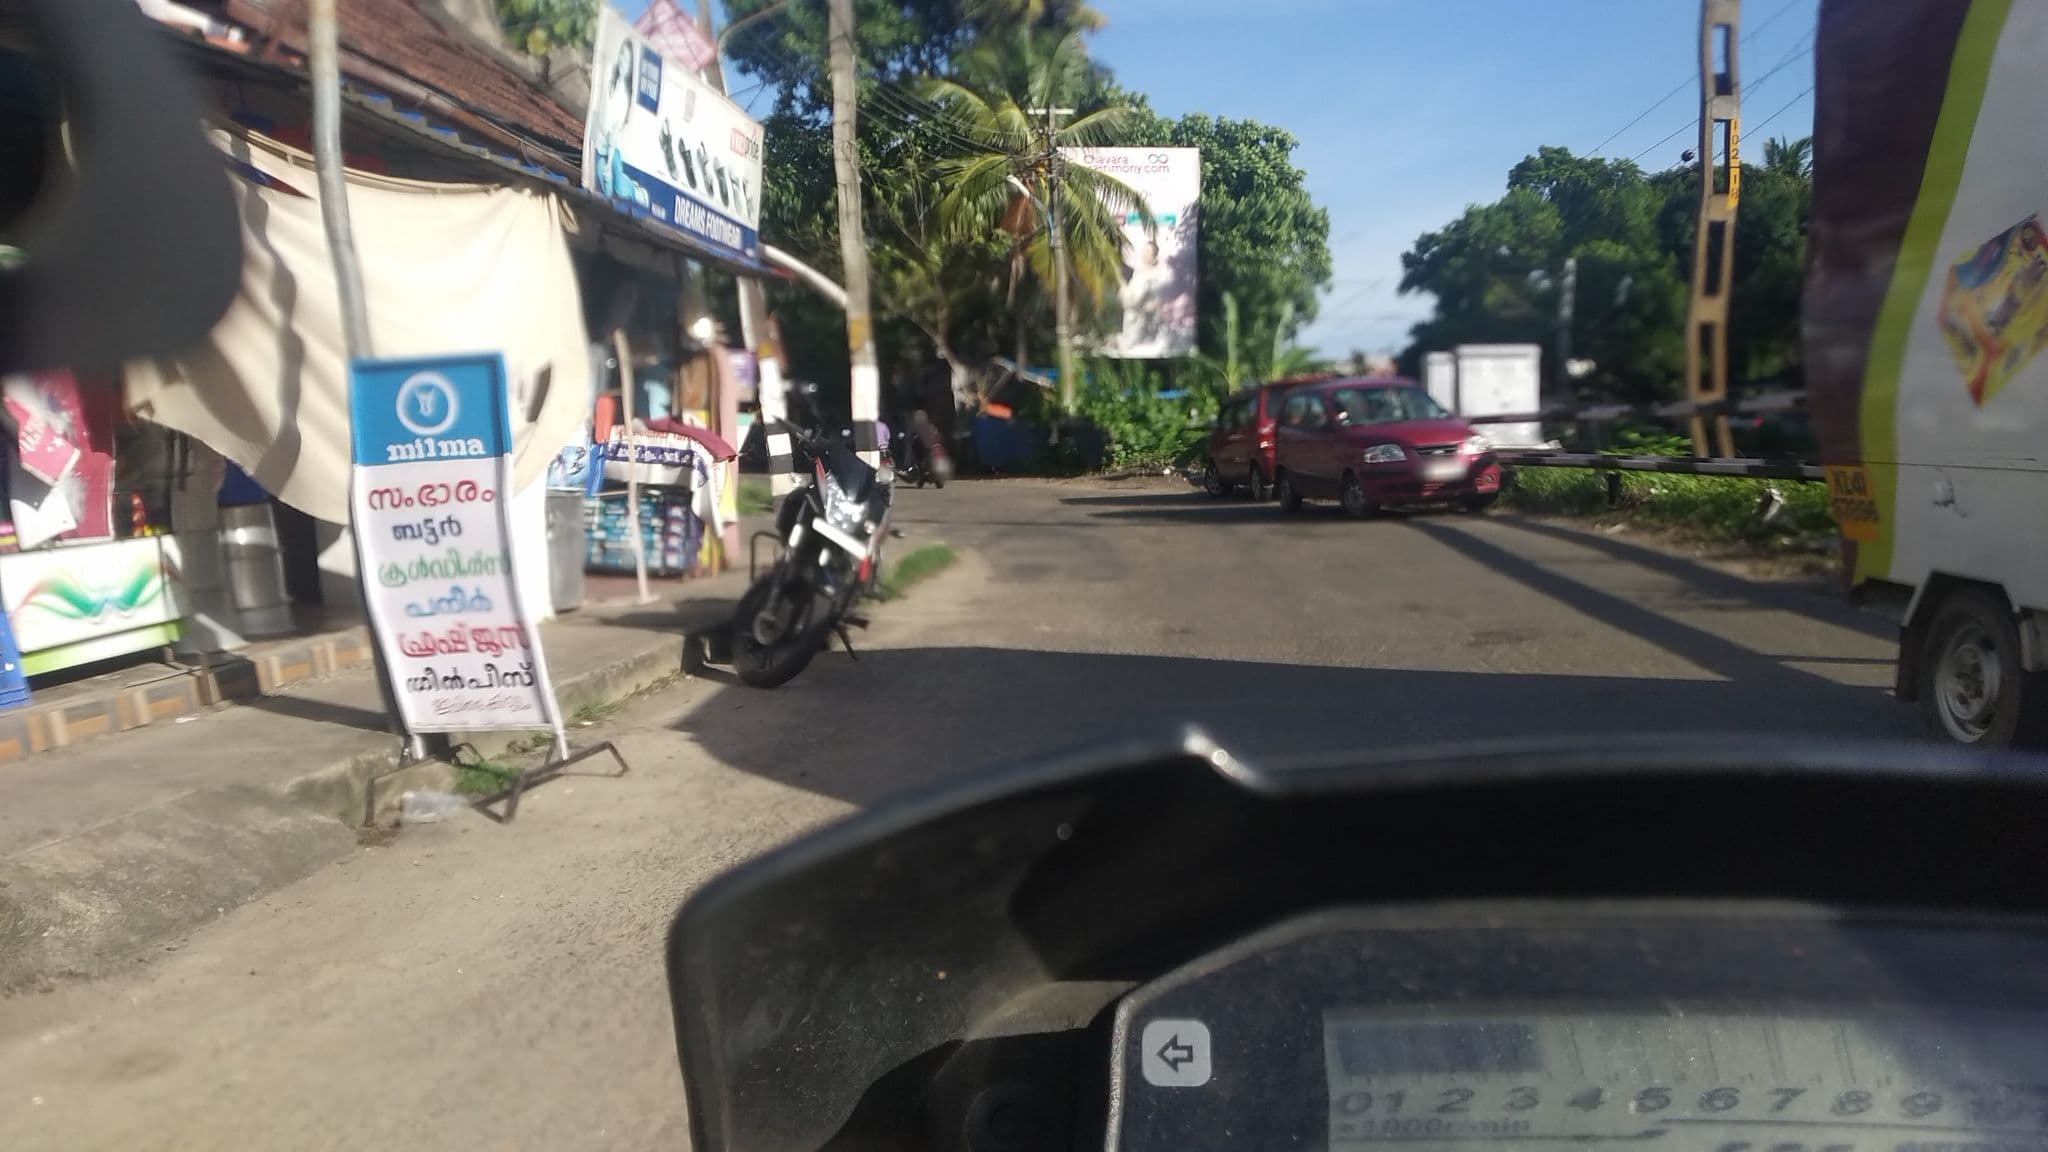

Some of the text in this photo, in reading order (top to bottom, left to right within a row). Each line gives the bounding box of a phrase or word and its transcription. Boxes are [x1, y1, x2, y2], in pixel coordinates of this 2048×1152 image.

[674, 194, 706, 235] DREAMS
[705, 211, 743, 250] FOOTWEAR
[386, 437, 487, 461] milma
[1436, 1087, 1474, 1113] 2
[1767, 1087, 1808, 1112] 7
